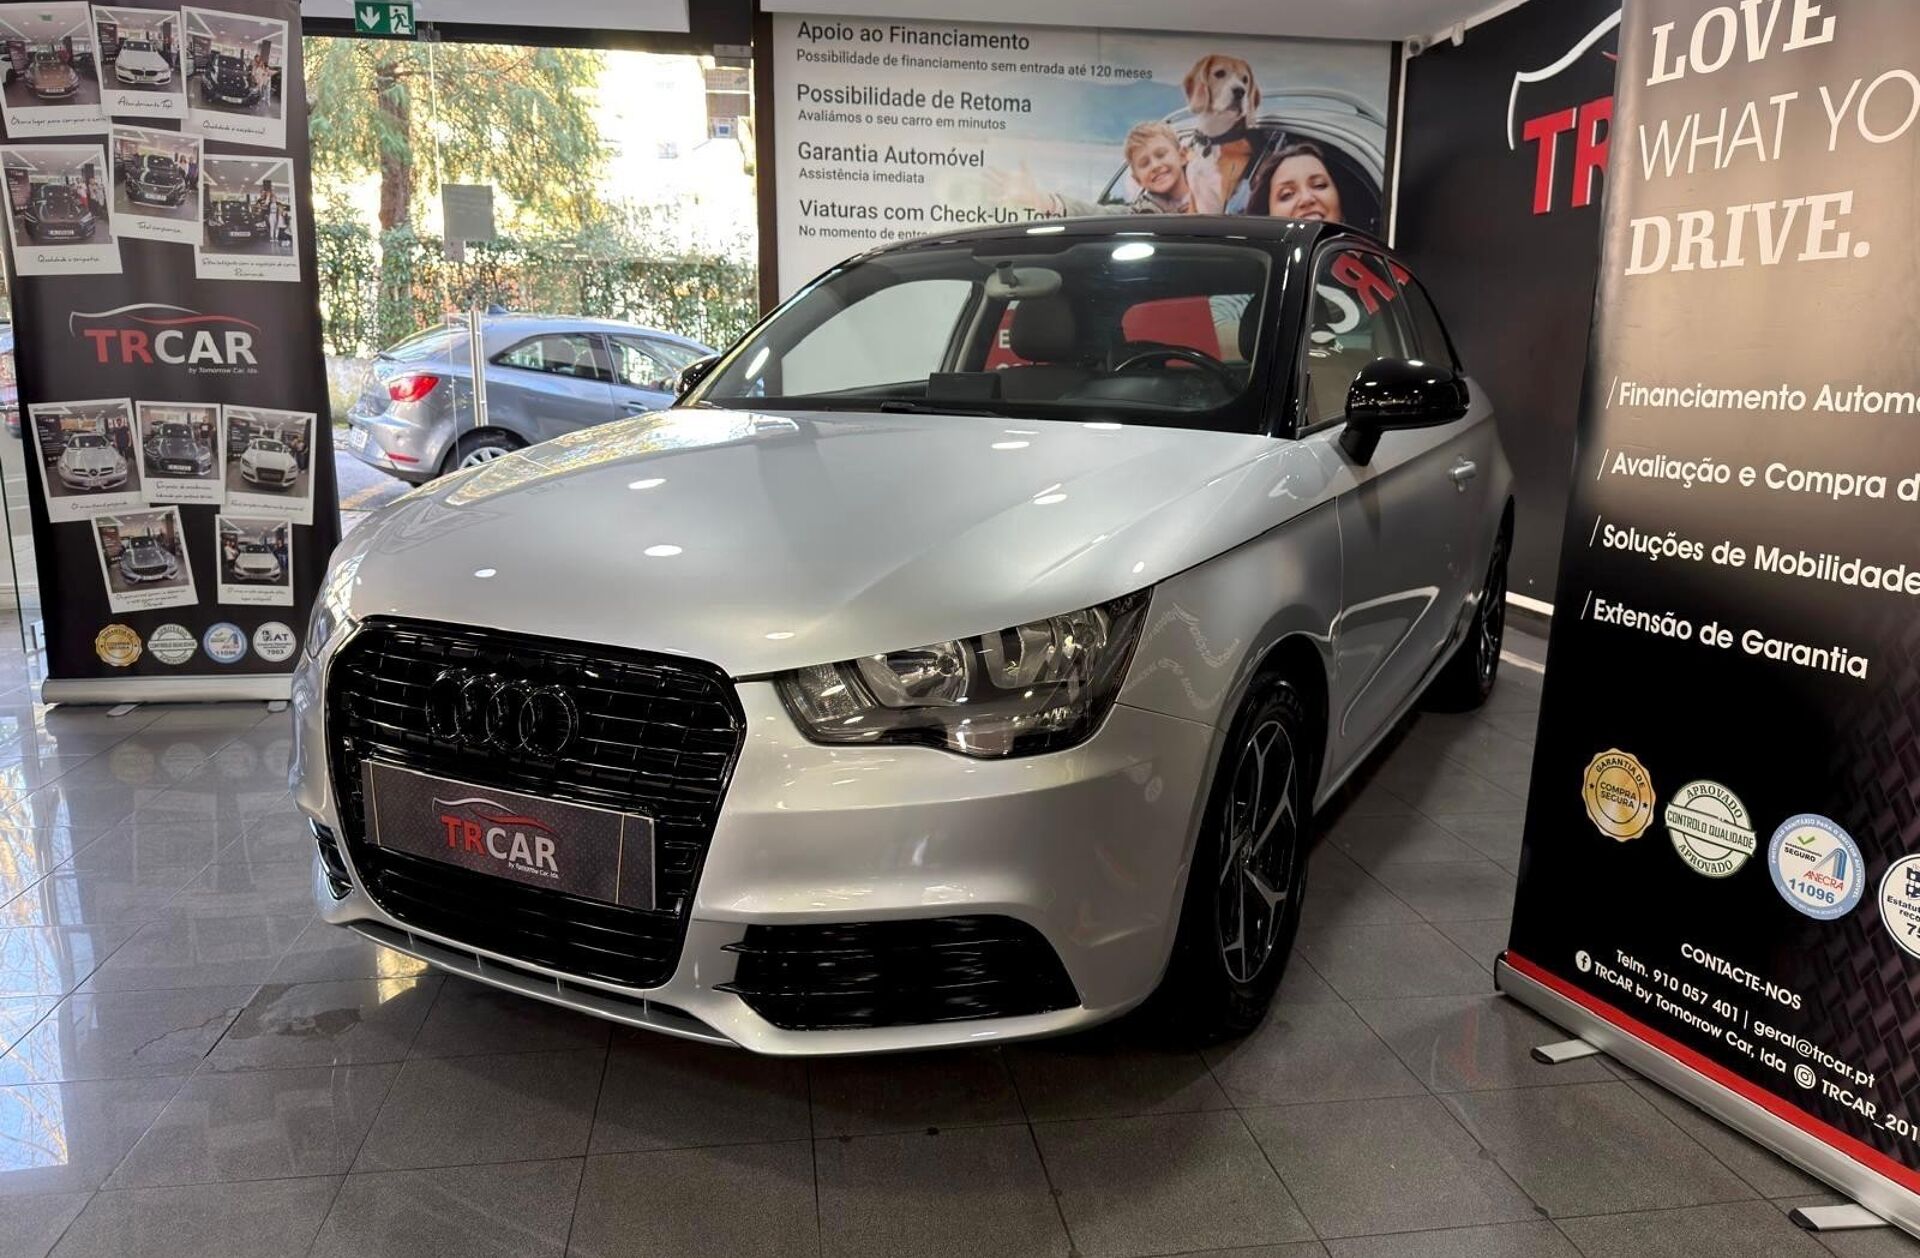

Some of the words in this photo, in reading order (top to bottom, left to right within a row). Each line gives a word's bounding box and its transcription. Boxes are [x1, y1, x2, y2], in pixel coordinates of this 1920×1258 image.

[797, 21, 853, 43] Apoio
[860, 27, 883, 42] ao
[890, 26, 1030, 50] Financiamento
[1645, 0, 1836, 87] LOVE
[797, 49, 880, 65] Possibilidade
[883, 54, 898, 66] de
[901, 55, 988, 71] financiamento
[991, 61, 1017, 72] sem
[1020, 62, 1065, 75] entrada
[1068, 63, 1087, 76] até
[1091, 64, 1111, 77] 120
[1114, 67, 1153, 79] meses
[797, 83, 926, 108] Possibilidade
[932, 89, 955, 108] de
[960, 91, 1032, 113] Retoma
[798, 110, 863, 124] Avaliámos
[865, 115, 874, 124] o
[876, 115, 898, 125] seu
[901, 115, 933, 127] carro
[936, 117, 955, 128] em
[958, 116, 1007, 130] minutos
[1639, 91, 1799, 181] WHAT
[798, 141, 878, 163] Garantia
[884, 146, 985, 167] Automóvel
[799, 168, 870, 182] Assistência
[873, 170, 925, 184] imediata
[800, 200, 878, 220] Viaturas
[884, 206, 924, 221] com
[799, 225, 816, 237] No
[819, 228, 877, 240] momento
[880, 228, 895, 240] de
[1624, 190, 1871, 276] DRIVE.
[83, 329, 258, 364] TRCAR
[1812, 384, 1920, 414] Autom
[1738, 466, 1756, 487] e
[1765, 462, 1887, 500] Compra
[1711, 541, 1746, 567] de
[1754, 545, 1920, 595] Mobilidade
[1700, 621, 1733, 648] de
[1741, 629, 1869, 679] Garantia
[1595, 757, 1636, 777] GARANTIA
[1600, 781, 1636, 801] COMPRA
[1686, 784, 1743, 818] APROVADO
[440, 814, 559, 872] TRCAR
[1667, 810, 1707, 834] CONTROLO
[1709, 824, 1754, 849] QUALIDADE
[1678, 844, 1733, 873] APROVADO
[1784, 846, 1817, 863] SEGURO
[1789, 878, 1835, 904] 11096
[1803, 870, 1844, 891] ANECRA
[1681, 943, 1802, 1010] CONTACTE-NOS
[1594, 961, 1633, 993] TRCAR
[1635, 983, 1652, 1004] by
[1655, 993, 1722, 1038] Tomorrow
[1725, 1031, 1755, 1058] Car,
[1760, 1047, 1787, 1073] lda
[1616, 949, 1649, 978] Telm.
[1653, 969, 1679, 991] 910
[1682, 983, 1708, 1005] 057
[1712, 1000, 1738, 1022] 401
[1754, 1020, 1875, 1089] geral@trcar.pt
